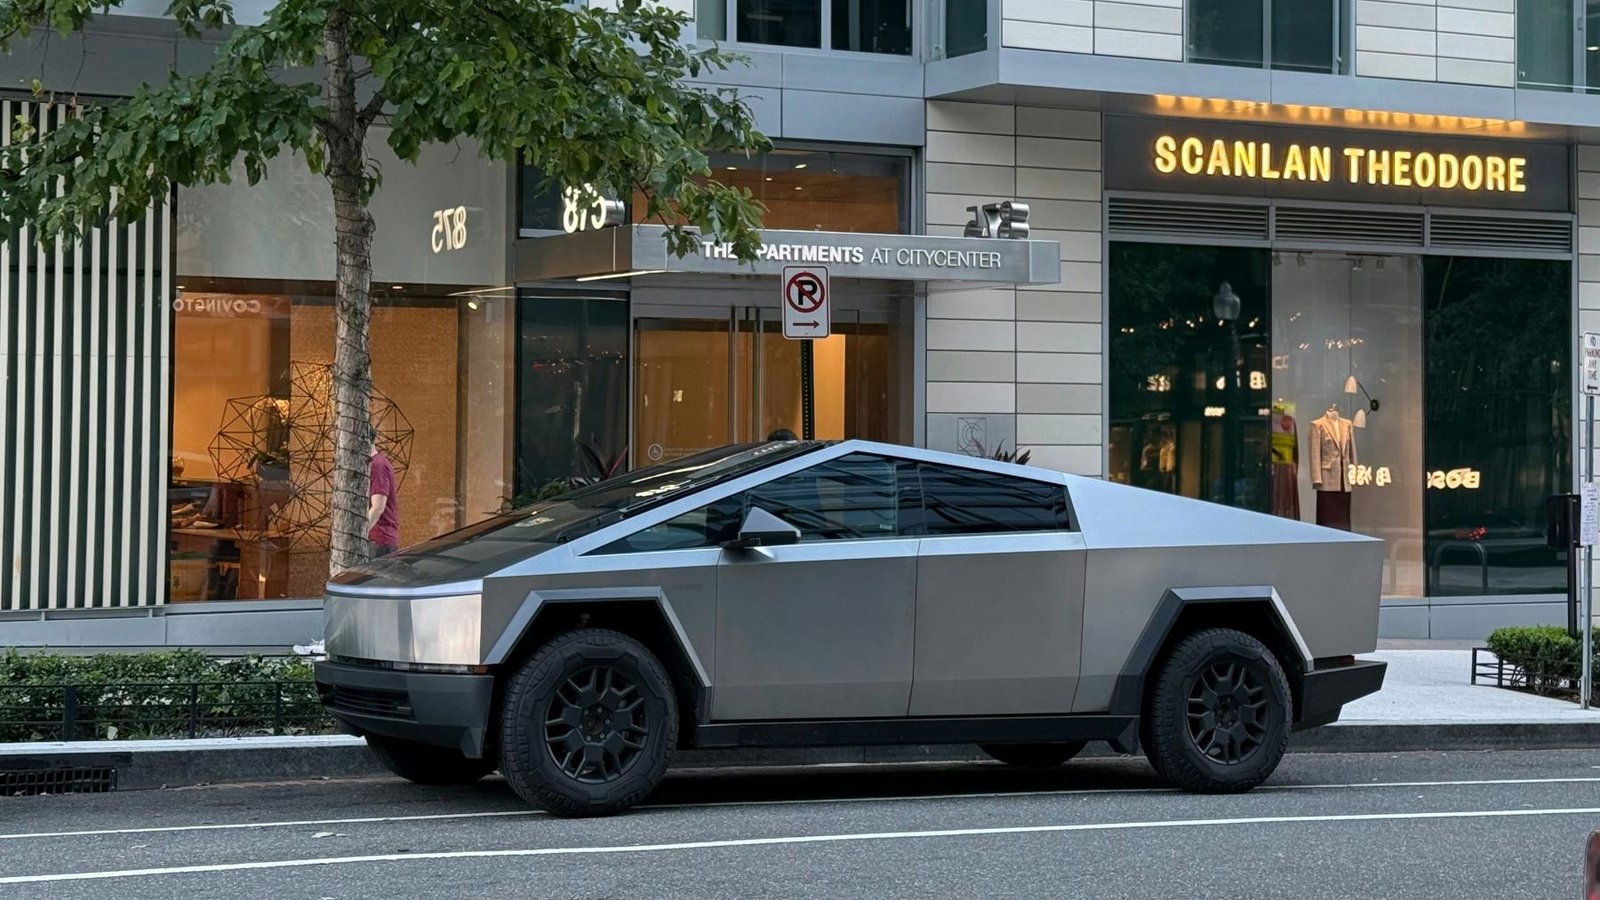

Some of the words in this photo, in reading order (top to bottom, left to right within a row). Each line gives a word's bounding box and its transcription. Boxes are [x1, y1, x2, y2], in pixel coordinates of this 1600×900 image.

[1155, 135, 1332, 182] SCANLAN
[1343, 147, 1527, 193] THEODORE
[757, 243, 864, 264] PARTMENTS
[870, 247, 892, 264] AT
[896, 248, 1001, 268] CITYCENTER
